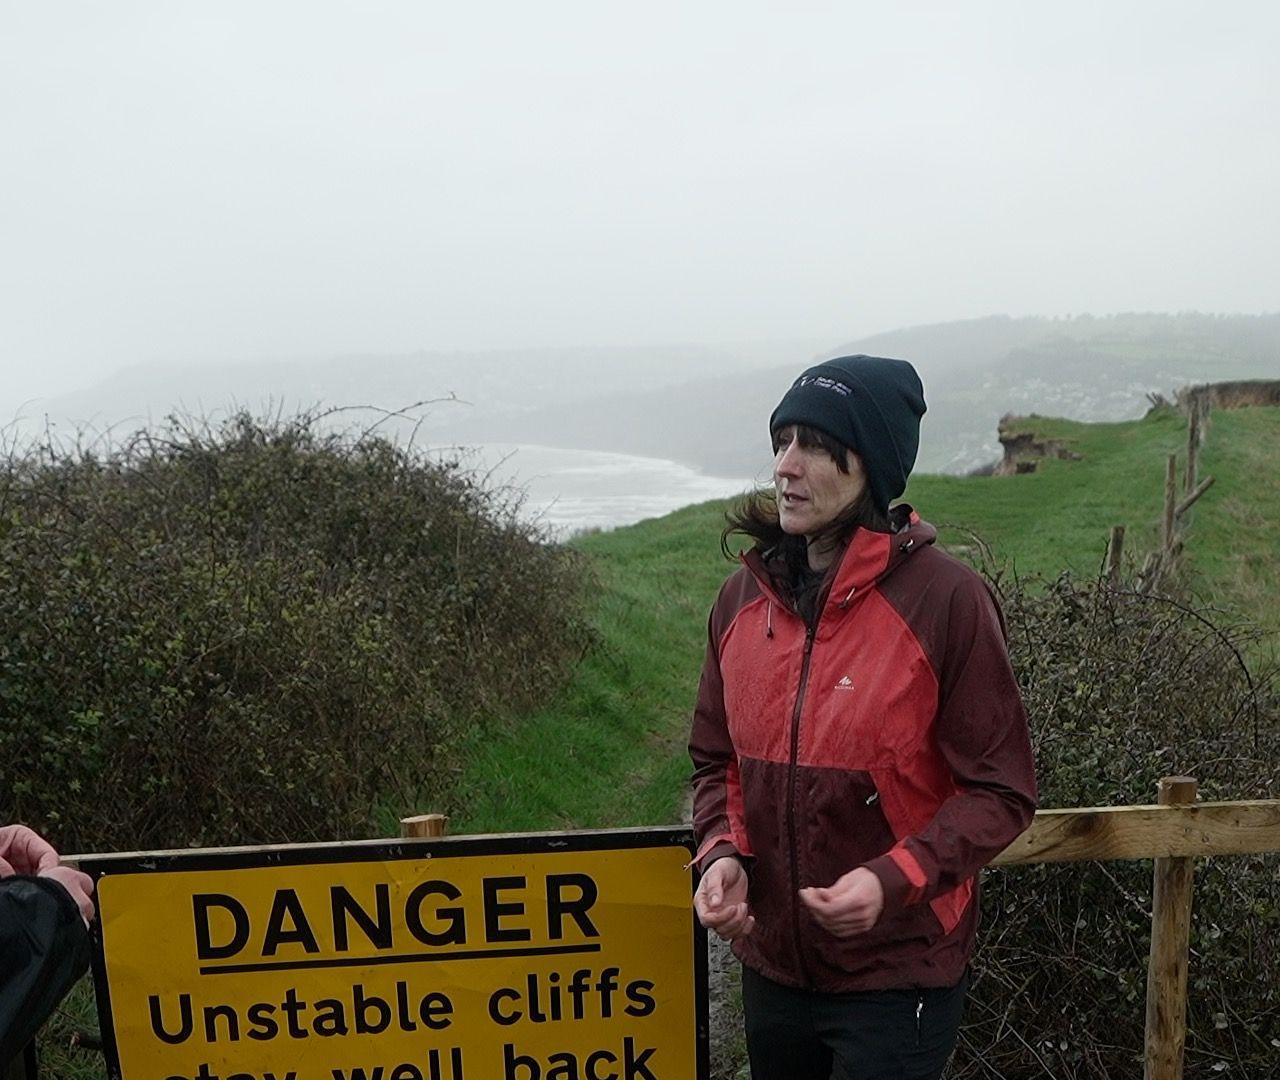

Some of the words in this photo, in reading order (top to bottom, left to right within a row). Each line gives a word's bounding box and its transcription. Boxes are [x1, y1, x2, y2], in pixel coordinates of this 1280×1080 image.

[192, 873, 600, 961] DANGER
[148, 981, 454, 1045] Unstable
[488, 967, 656, 1026] cliffs
